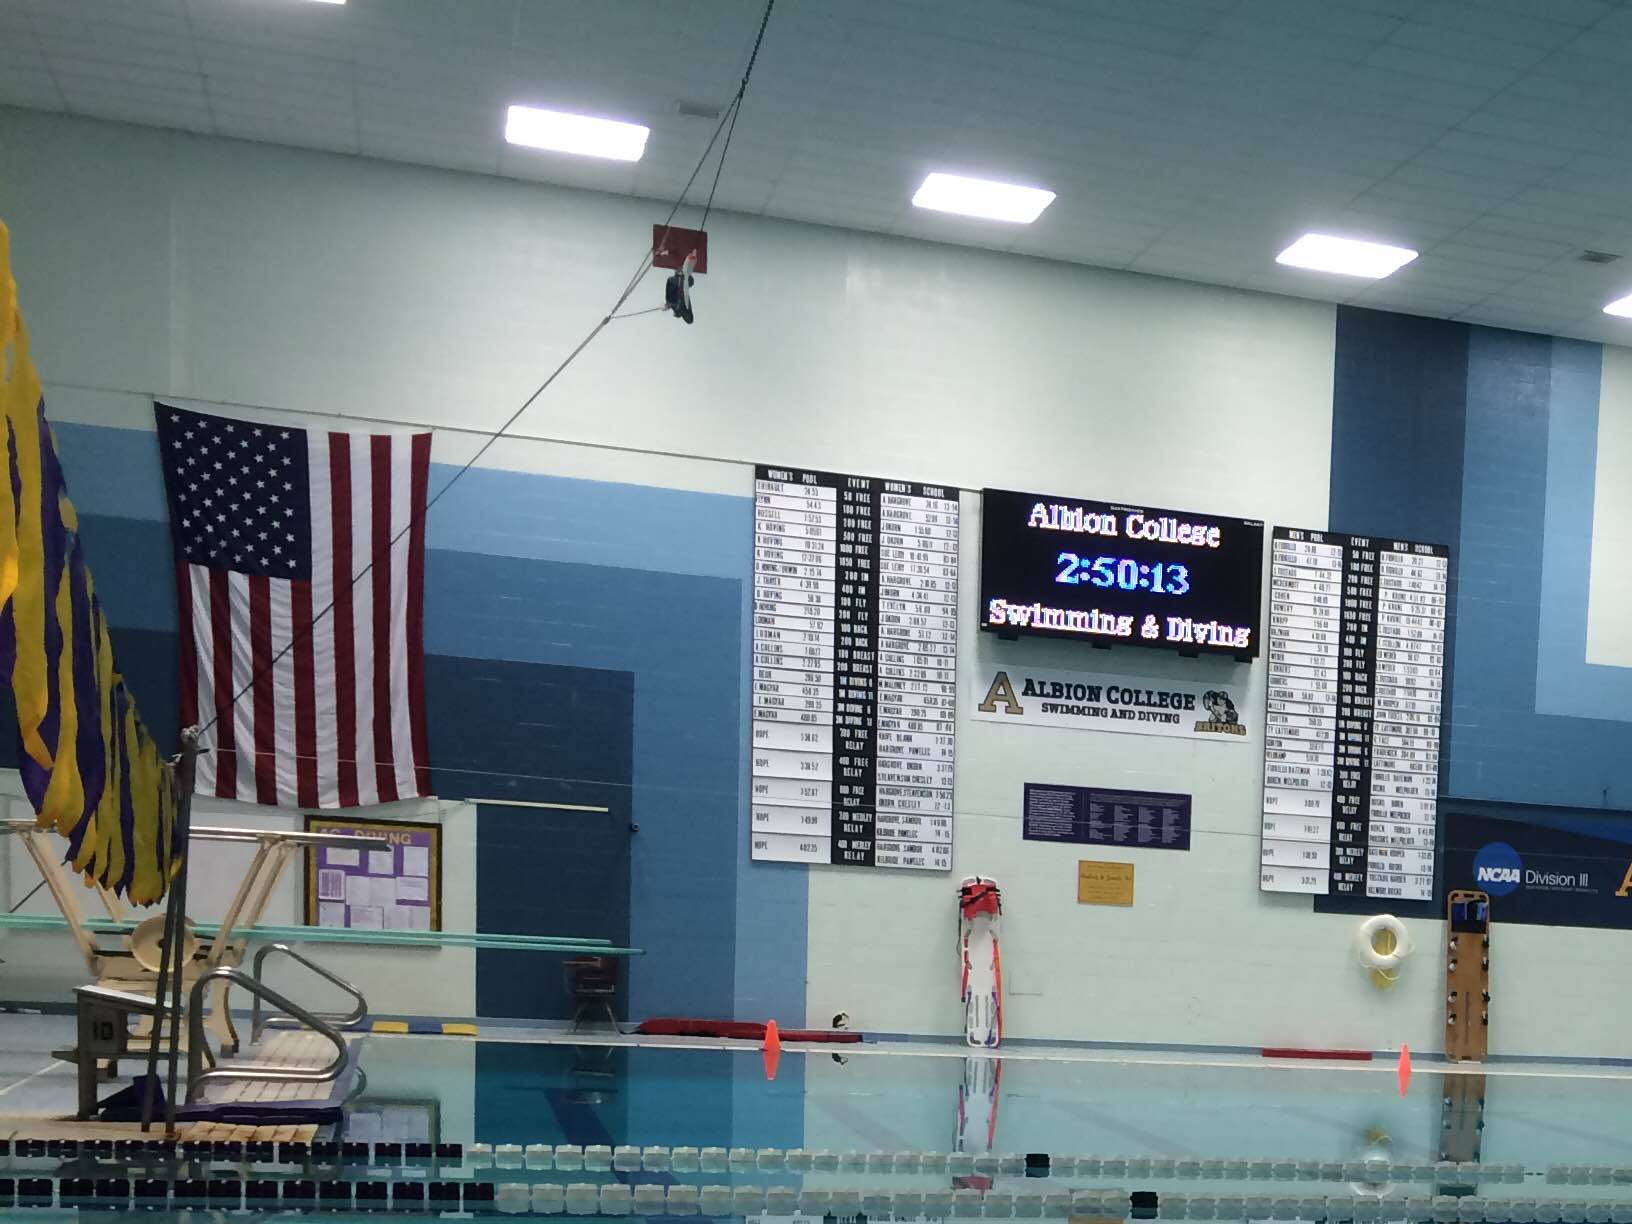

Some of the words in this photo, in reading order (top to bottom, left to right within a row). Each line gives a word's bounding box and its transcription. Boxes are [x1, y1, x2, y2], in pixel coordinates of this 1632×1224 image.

[803, 474, 817, 484] POOL
[848, 478, 870, 489] EVENT
[885, 482, 912, 494] WOMEN'S
[923, 486, 944, 498] SCHOOL
[844, 491, 852, 501] 50
[856, 493, 870, 503] FREE
[843, 505, 853, 514] 100
[856, 506, 871, 517] FREE
[843, 518, 855, 528] 200
[858, 519, 872, 530] FREE
[1028, 503, 1118, 536] Albion
[1126, 514, 1221, 548] College
[843, 531, 854, 541] 500
[858, 533, 873, 543] FREE
[1311, 532, 1324, 543] POOL
[1351, 536, 1369, 547] EVENT
[840, 544, 852, 554] 1000
[855, 545, 868, 555] FREE
[1352, 550, 1359, 559] 50
[1362, 550, 1375, 561] FREE
[840, 557, 852, 567] 1650
[858, 558, 870, 569] FREE
[1361, 563, 1373, 573] FREE
[845, 571, 858, 581] 200
[1055, 552, 1190, 595] 2:50:13
[1361, 576, 1373, 585] FREE
[842, 585, 853, 595] 400
[1347, 586, 1357, 596] 500
[1360, 587, 1372, 597] FREE
[841, 597, 851, 607] 100
[855, 599, 866, 608] FLY
[1360, 599, 1373, 610] FREE
[839, 610, 850, 619] 200
[858, 611, 868, 621] FLY
[1359, 612, 1372, 622] FREE
[841, 623, 851, 633] 100
[854, 624, 868, 634] BACK
[989, 599, 1134, 636] Swimming
[1141, 614, 1159, 639] &
[1166, 616, 1251, 648] Diving
[841, 637, 851, 646] 200
[856, 638, 868, 648] BACK
[839, 650, 848, 659] 100
[853, 651, 874, 661] BREAST
[1355, 648, 1364, 658] FLY
[837, 662, 848, 672] 200
[853, 664, 873, 674] BREAST
[1356, 660, 1365, 670] FLY
[978, 671, 1023, 715] A
[1022, 678, 1103, 703] ALBION
[1106, 685, 1195, 710] COLLEGE
[1041, 702, 1108, 719] SWIMMING
[1110, 708, 1137, 720] AND
[1138, 711, 1180, 724] DIVING
[840, 729, 851, 739] 200
[855, 729, 868, 739] FREE
[846, 741, 864, 751] RELAY
[839, 757, 850, 766] 400
[854, 757, 869, 768] FREE
[843, 767, 863, 778] RELAY
[853, 786, 864, 795] FREE
[843, 798, 860, 807] RELAY
[852, 812, 873, 823] MEDLEY
[844, 823, 863, 834] RELAY
[852, 840, 872, 851] MEDLEY
[844, 851, 864, 861] RELAY
[1477, 867, 1520, 883] NCAA
[1526, 870, 1575, 886] Division
[1579, 873, 1588, 886] III
